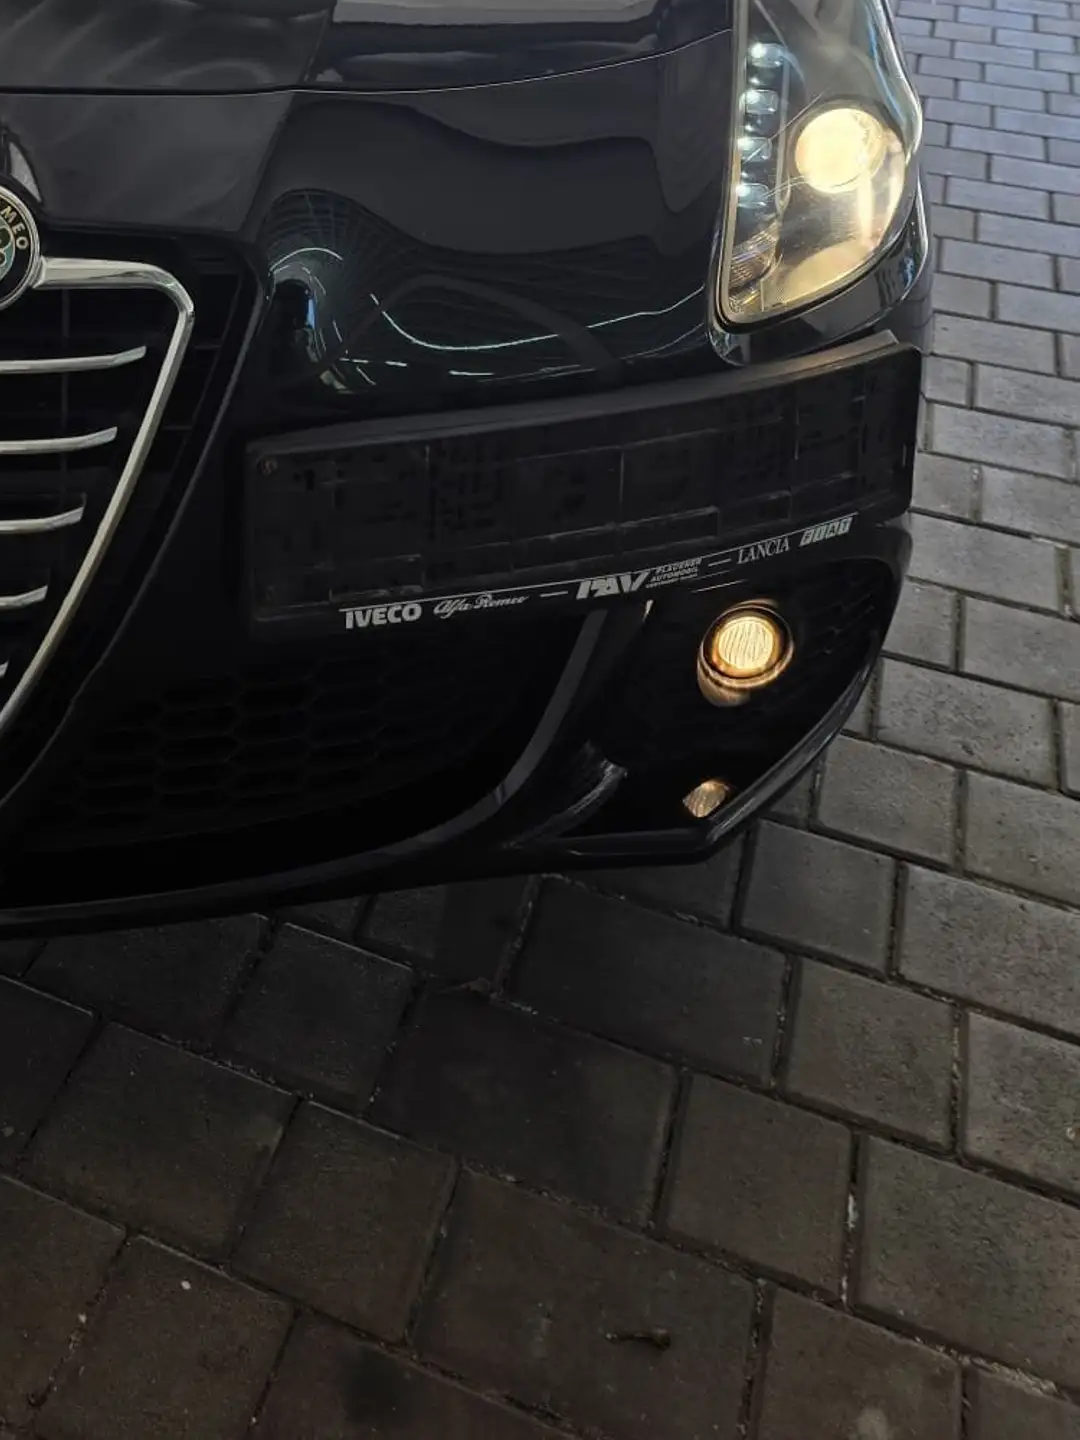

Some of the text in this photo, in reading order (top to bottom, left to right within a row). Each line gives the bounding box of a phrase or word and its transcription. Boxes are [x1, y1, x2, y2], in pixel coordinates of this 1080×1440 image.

[345, 603, 422, 630] IVECO
[433, 599, 471, 619] Alfa
[737, 537, 790, 564] LANCIA
